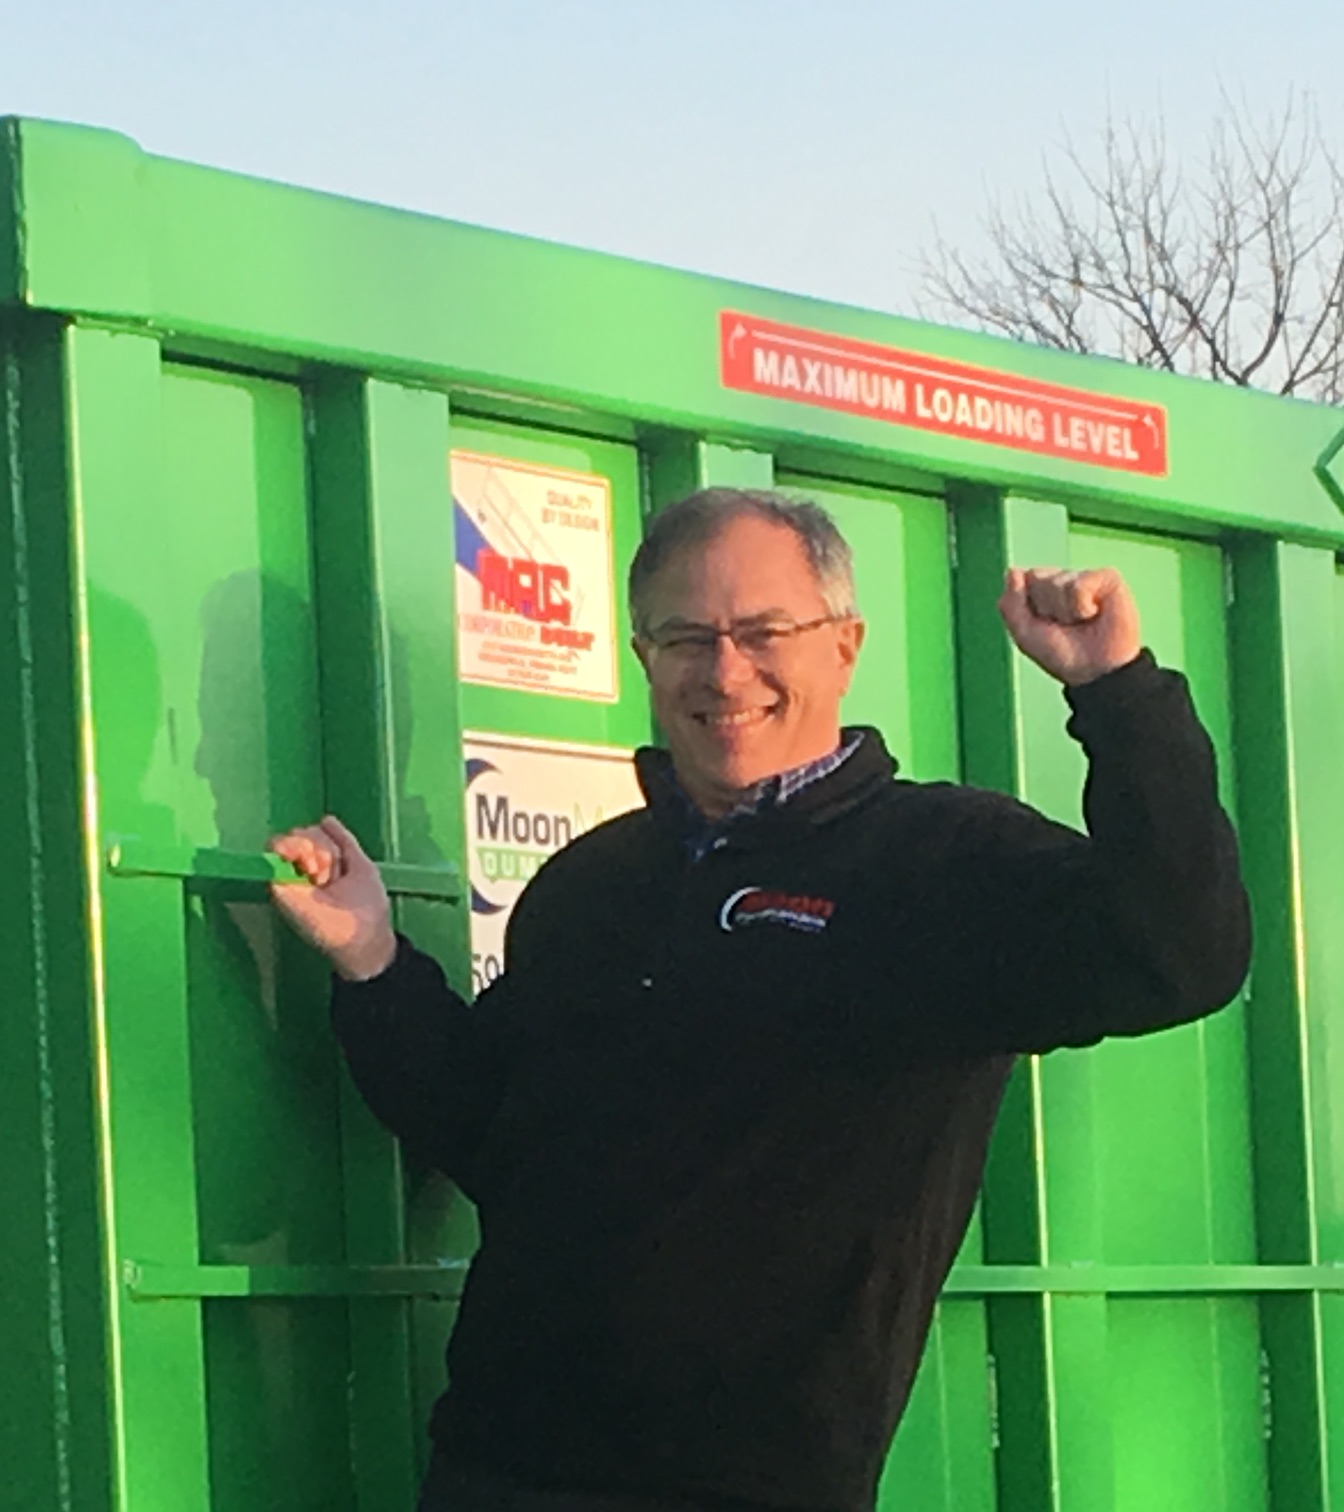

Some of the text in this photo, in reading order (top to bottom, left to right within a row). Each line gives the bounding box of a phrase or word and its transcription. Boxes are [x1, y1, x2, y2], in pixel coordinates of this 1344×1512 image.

[752, 348, 1139, 460] MAXIMUM LOADING LEVEL
